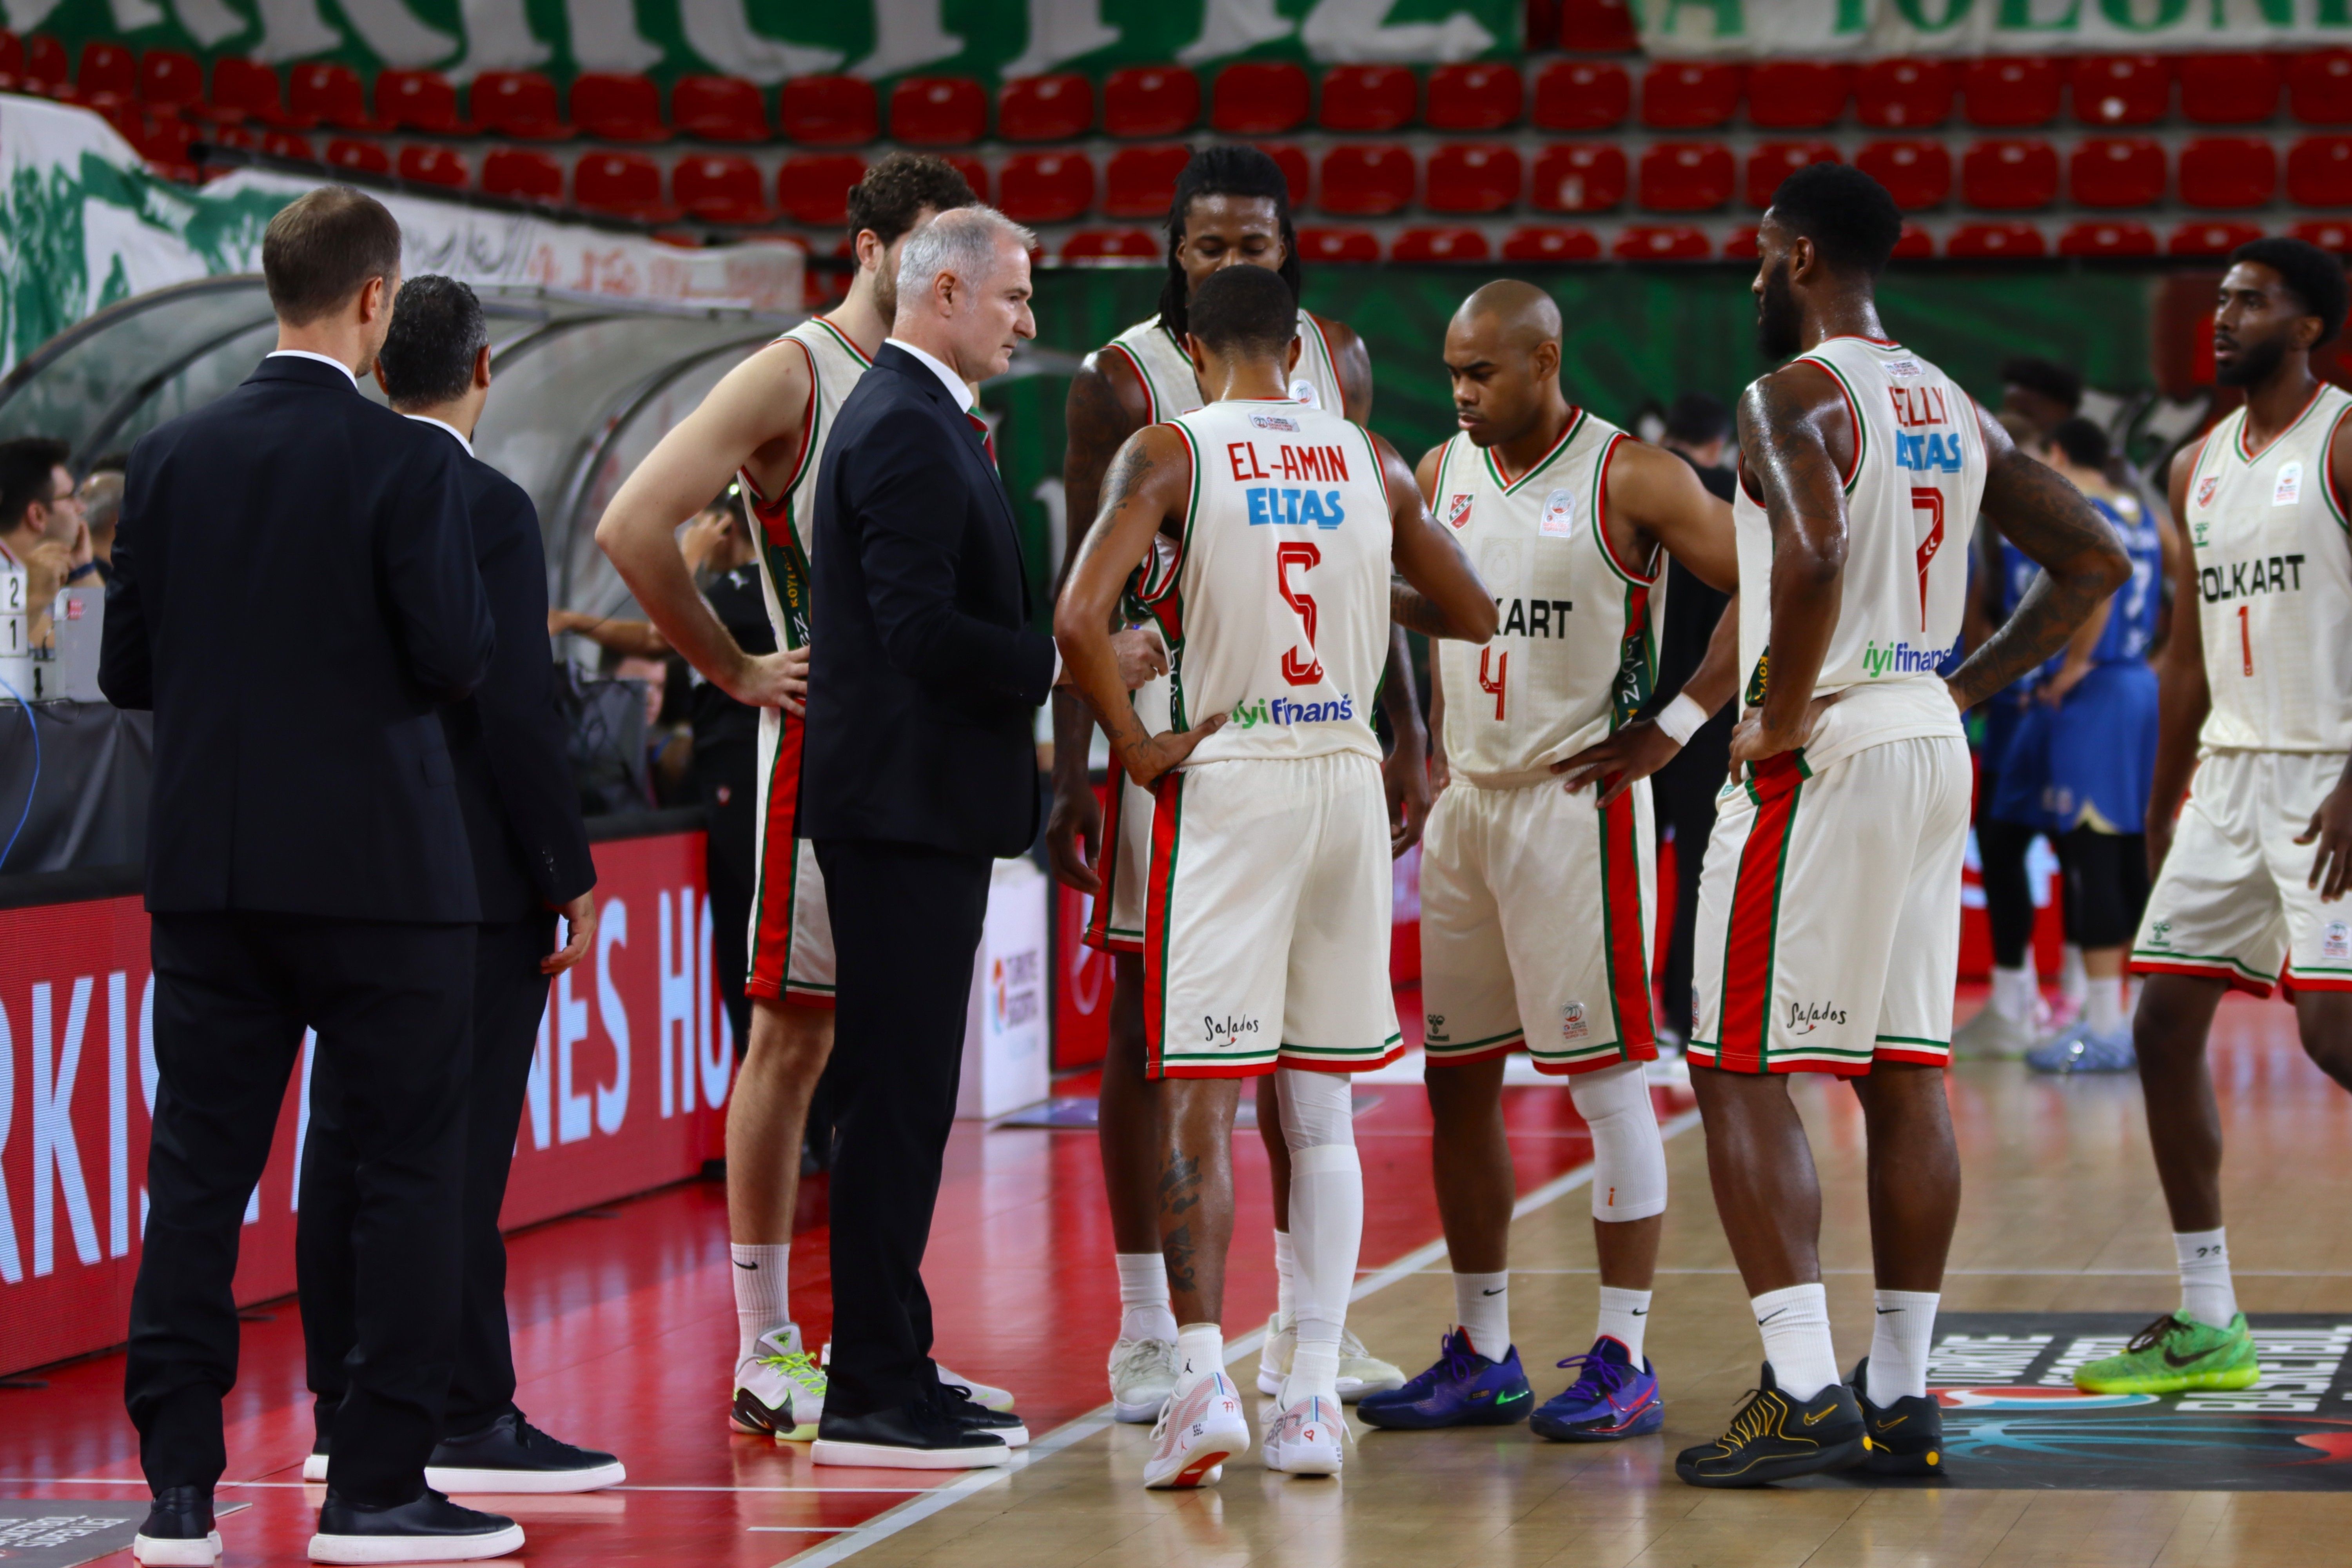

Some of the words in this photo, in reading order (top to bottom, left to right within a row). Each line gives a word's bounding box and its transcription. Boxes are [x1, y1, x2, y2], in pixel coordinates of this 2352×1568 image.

[1227, 442, 1349, 482] EL-AMIN
[1911, 487, 1944, 632] 7
[2197, 554, 2305, 604] OLKART
[1276, 542, 1324, 686] 5
[2237, 606, 2253, 677] 1
[1479, 645, 1508, 721] 4
[1205, 1014, 1259, 1041] Salados
[1787, 1001, 1847, 1028] Salados
